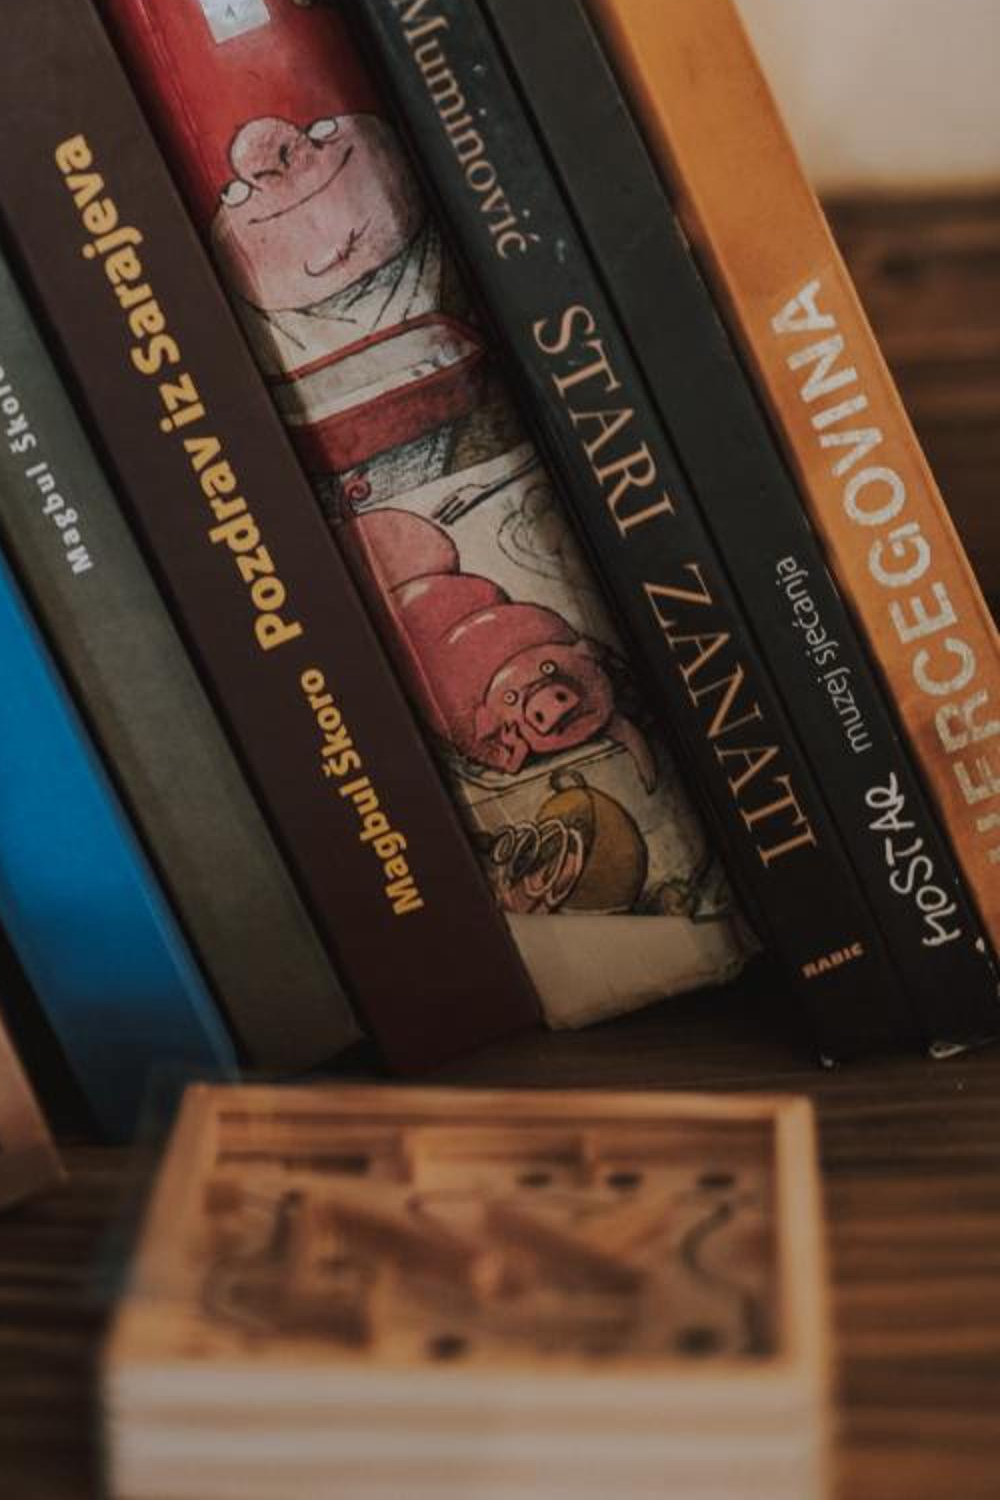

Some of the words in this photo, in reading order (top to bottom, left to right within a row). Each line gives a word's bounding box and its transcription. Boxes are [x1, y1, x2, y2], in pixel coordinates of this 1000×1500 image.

[55, 135, 180, 375] Sarajeva
[161, 374, 205, 432] iz
[25, 462, 94, 575] Magbul
[184, 436, 303, 651] Pozdrav
[533, 305, 675, 538] STARI
[643, 563, 817, 867] ZANATI
[776, 556, 839, 665] sjećanja
[301, 668, 362, 777] Škoro
[817, 667, 872, 753] muzej
[339, 776, 424, 915] Magbul
[865, 772, 960, 947] MOSTAR
